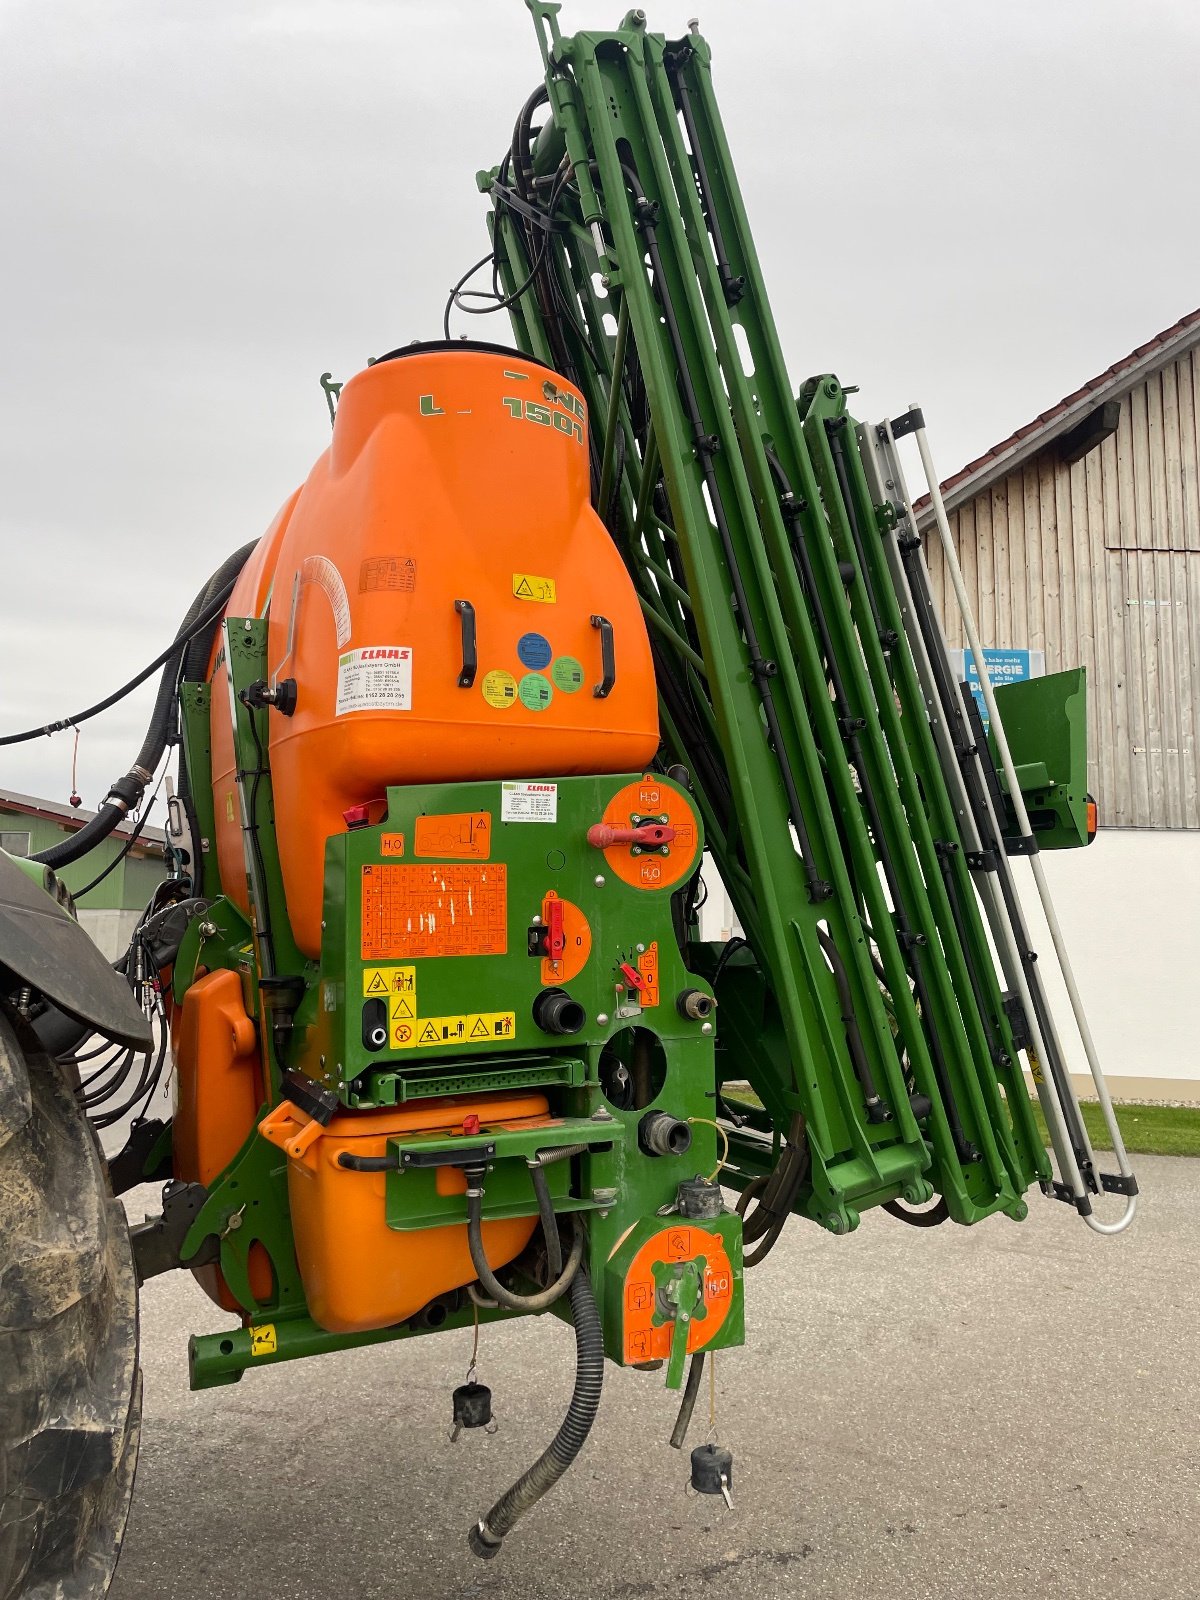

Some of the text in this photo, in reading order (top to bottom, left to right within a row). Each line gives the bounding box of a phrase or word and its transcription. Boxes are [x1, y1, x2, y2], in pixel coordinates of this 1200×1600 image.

[502, 396, 584, 446] 1501
[361, 650, 410, 660] CLAAS
[970, 665, 1023, 675] EERGIE
